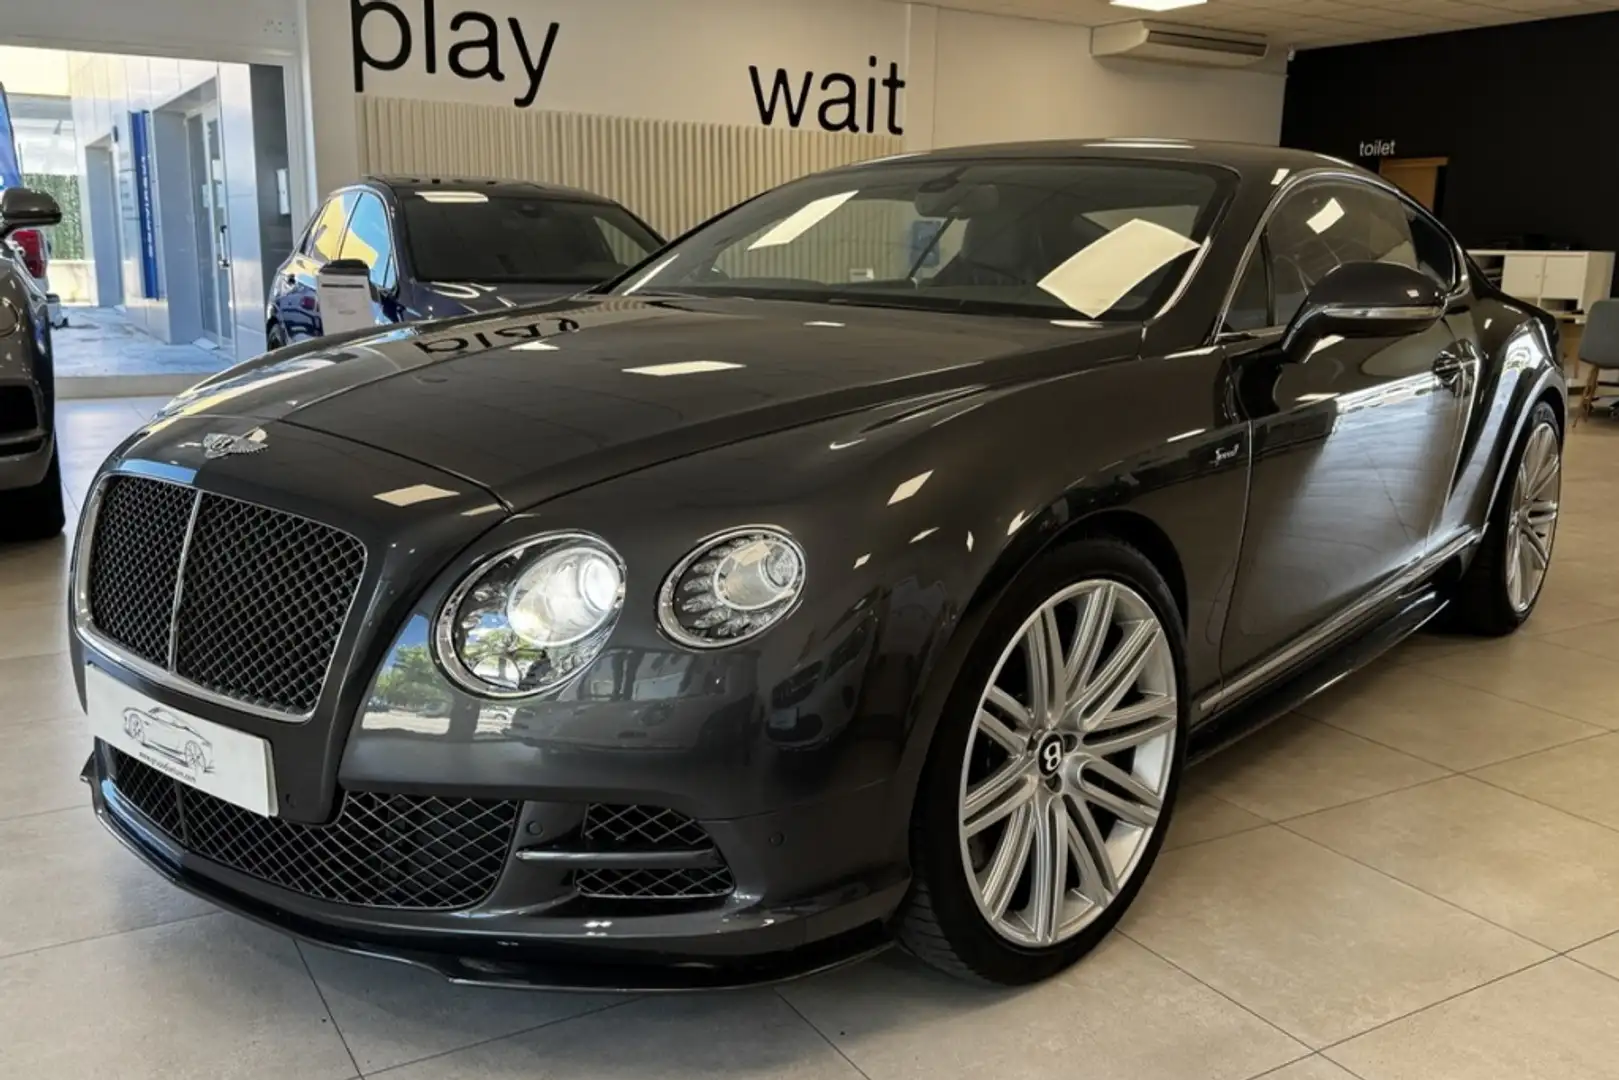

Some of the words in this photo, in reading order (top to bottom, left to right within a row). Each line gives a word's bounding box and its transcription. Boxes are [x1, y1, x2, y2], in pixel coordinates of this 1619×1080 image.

[351, 0, 560, 107] play
[748, 55, 906, 135] wait
[1359, 140, 1396, 156] toilet
